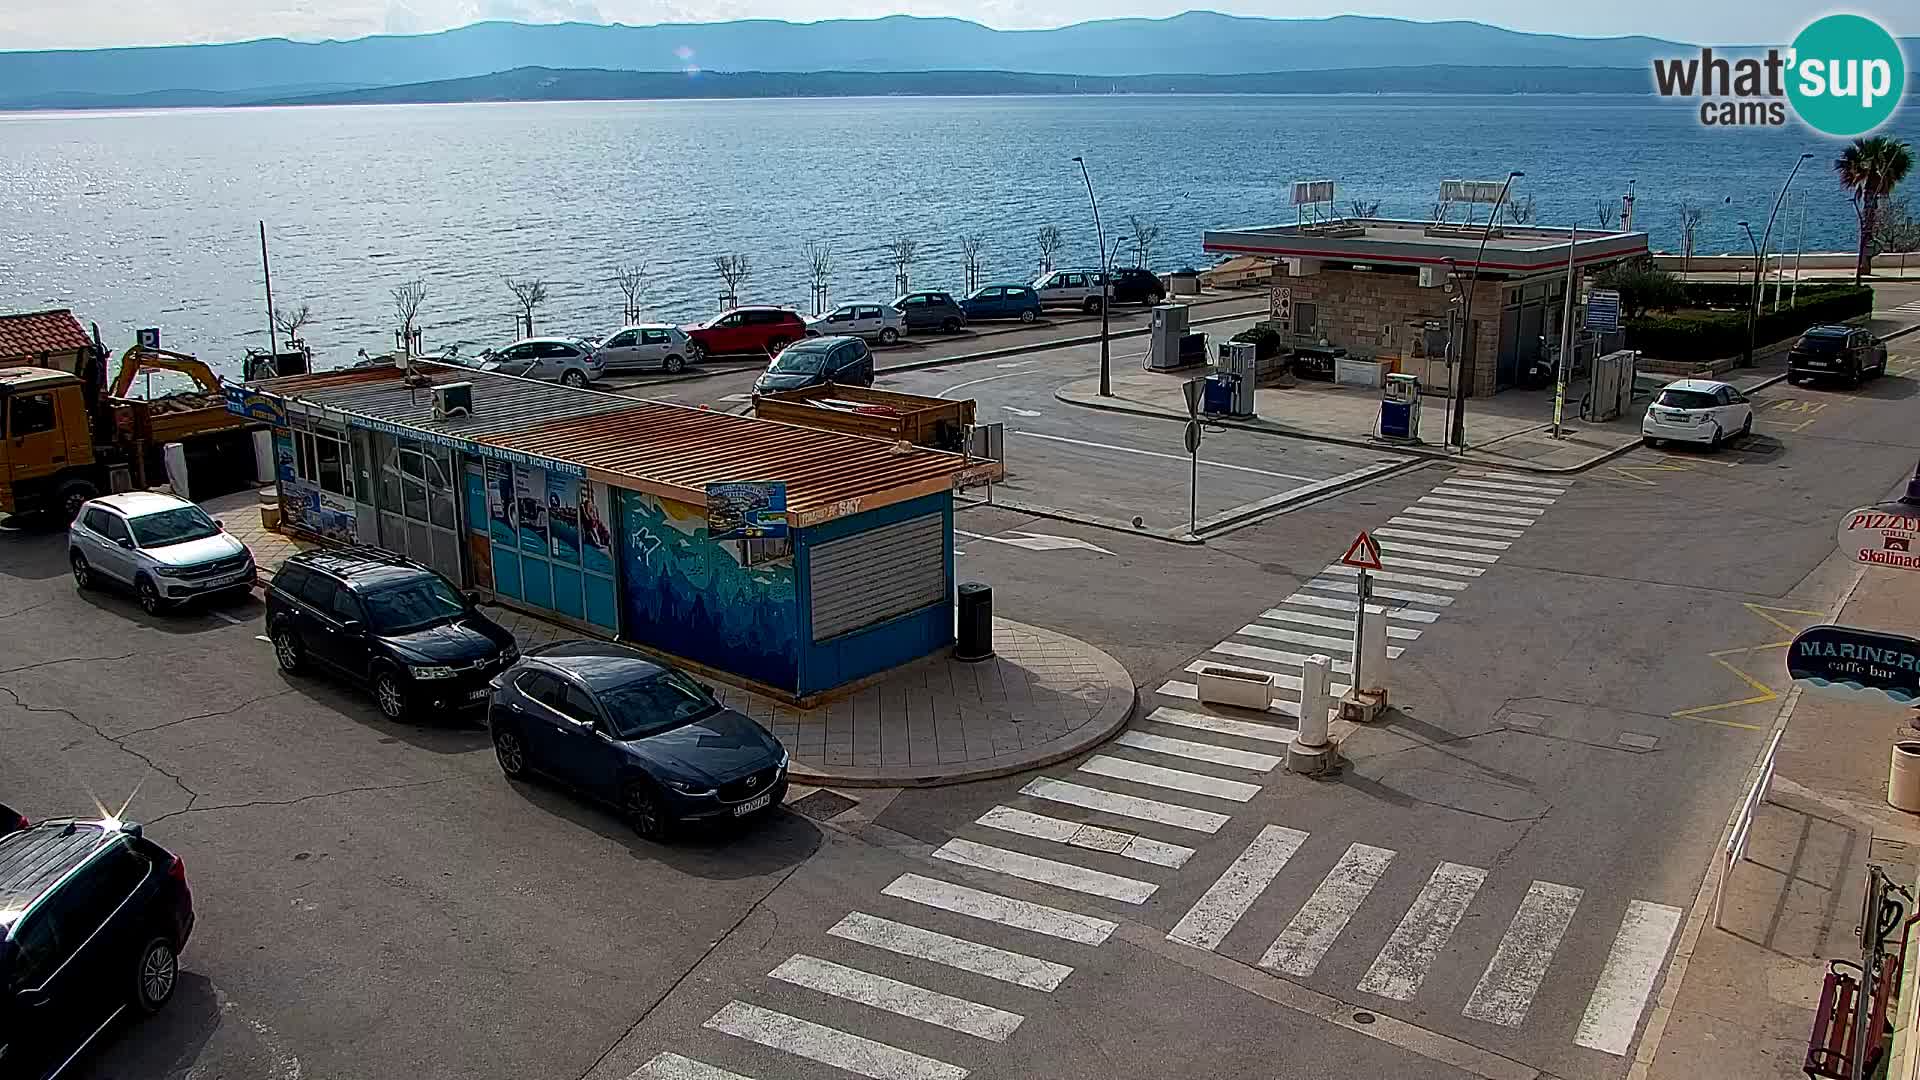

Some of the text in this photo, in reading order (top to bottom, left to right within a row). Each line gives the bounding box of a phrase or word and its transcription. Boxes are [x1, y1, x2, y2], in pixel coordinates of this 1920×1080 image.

[396, 425, 436, 442] AUTOBUSNA
[436, 435, 468, 450] POSTAJA
[478, 445, 493, 457] BUS
[494, 448, 527, 464] STATION
[528, 455, 554, 470] TICKET
[556, 460, 583, 476] OFFICE
[1847, 514, 1920, 533] PIZZE
[1880, 529, 1917, 540] GRILL
[1828, 661, 1896, 679] caffe bar
